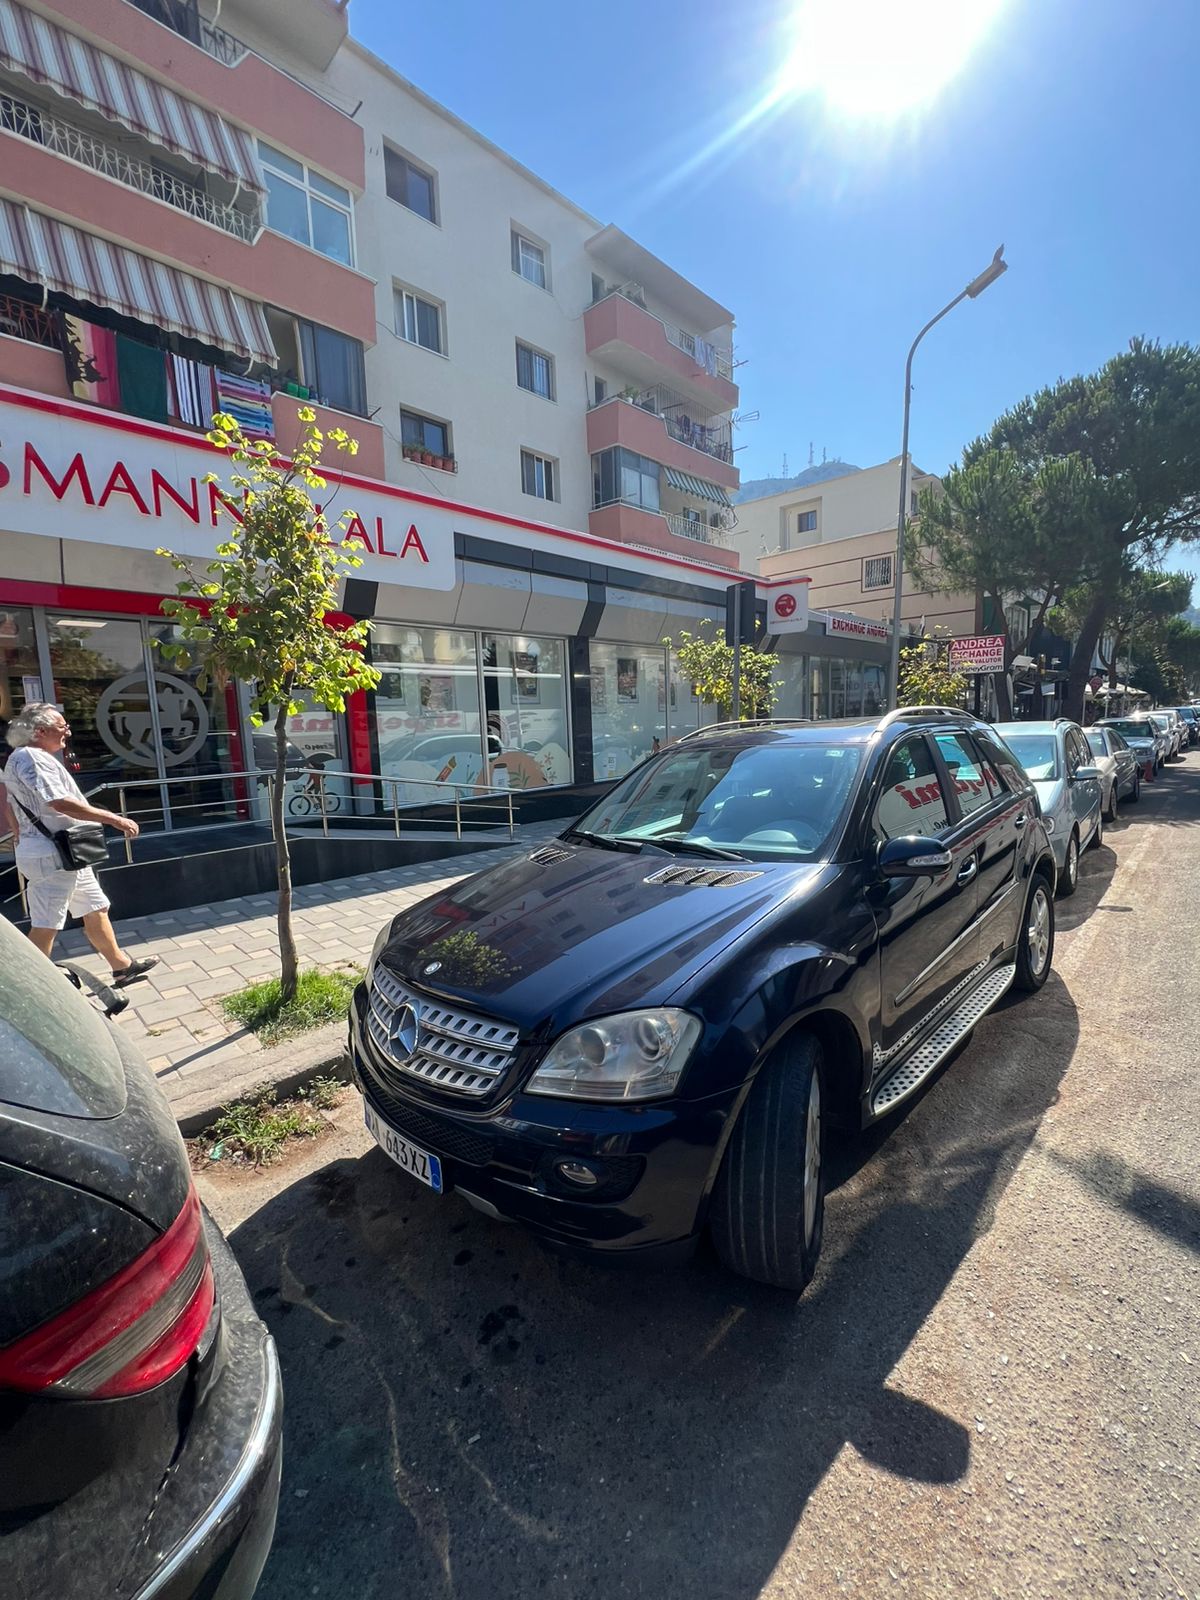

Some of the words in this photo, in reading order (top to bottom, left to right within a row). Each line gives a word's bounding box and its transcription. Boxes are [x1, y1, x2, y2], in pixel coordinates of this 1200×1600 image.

[0, 440, 251, 529] MANN
[832, 618, 866, 635] EXCHANGE
[867, 624, 888, 638] ANDREA
[952, 637, 1003, 650] ANDREA
